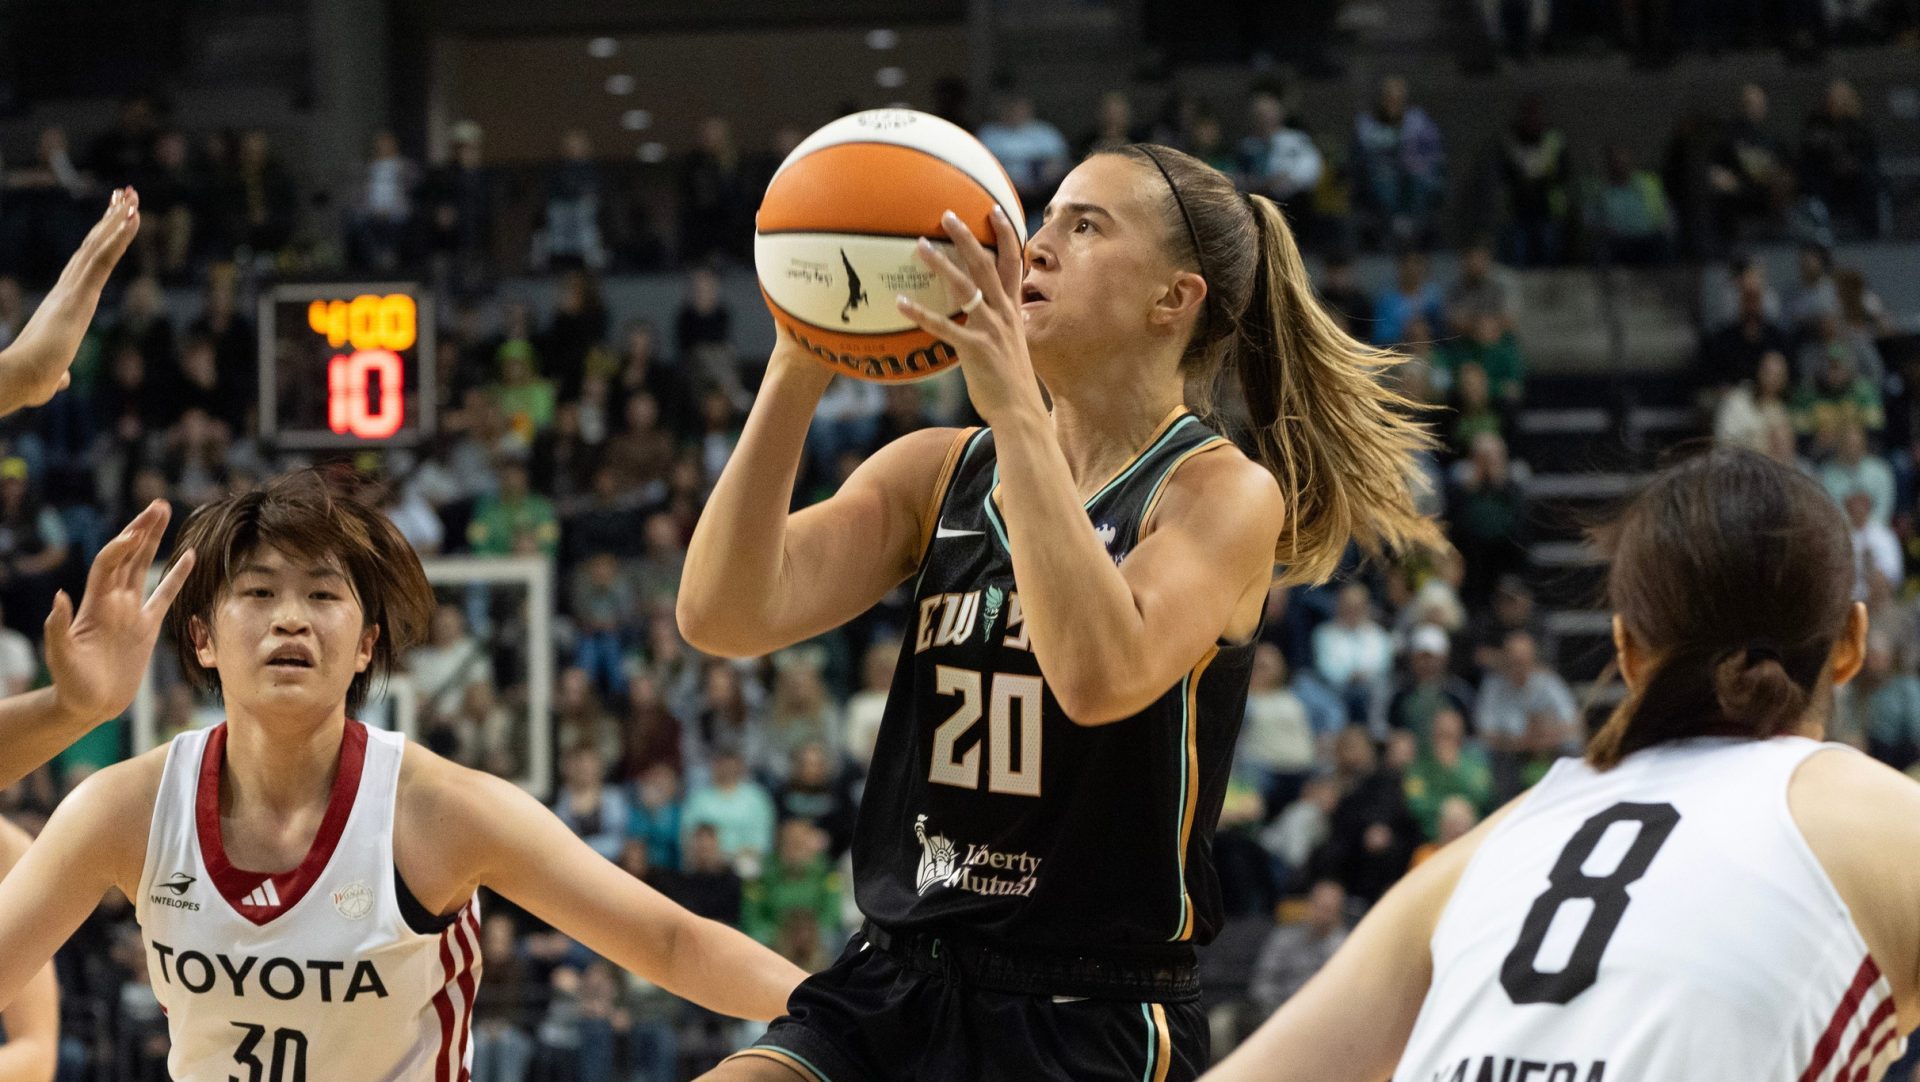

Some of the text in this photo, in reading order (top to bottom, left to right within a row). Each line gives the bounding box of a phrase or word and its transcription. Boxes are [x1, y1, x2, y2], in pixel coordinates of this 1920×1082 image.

[328, 350, 404, 439] 10
[914, 590, 981, 655] EW
[928, 664, 1043, 797] 20
[1499, 801, 1682, 1007] 8
[152, 940, 389, 1003] TOYOTA
[228, 1021, 308, 1082] 30
